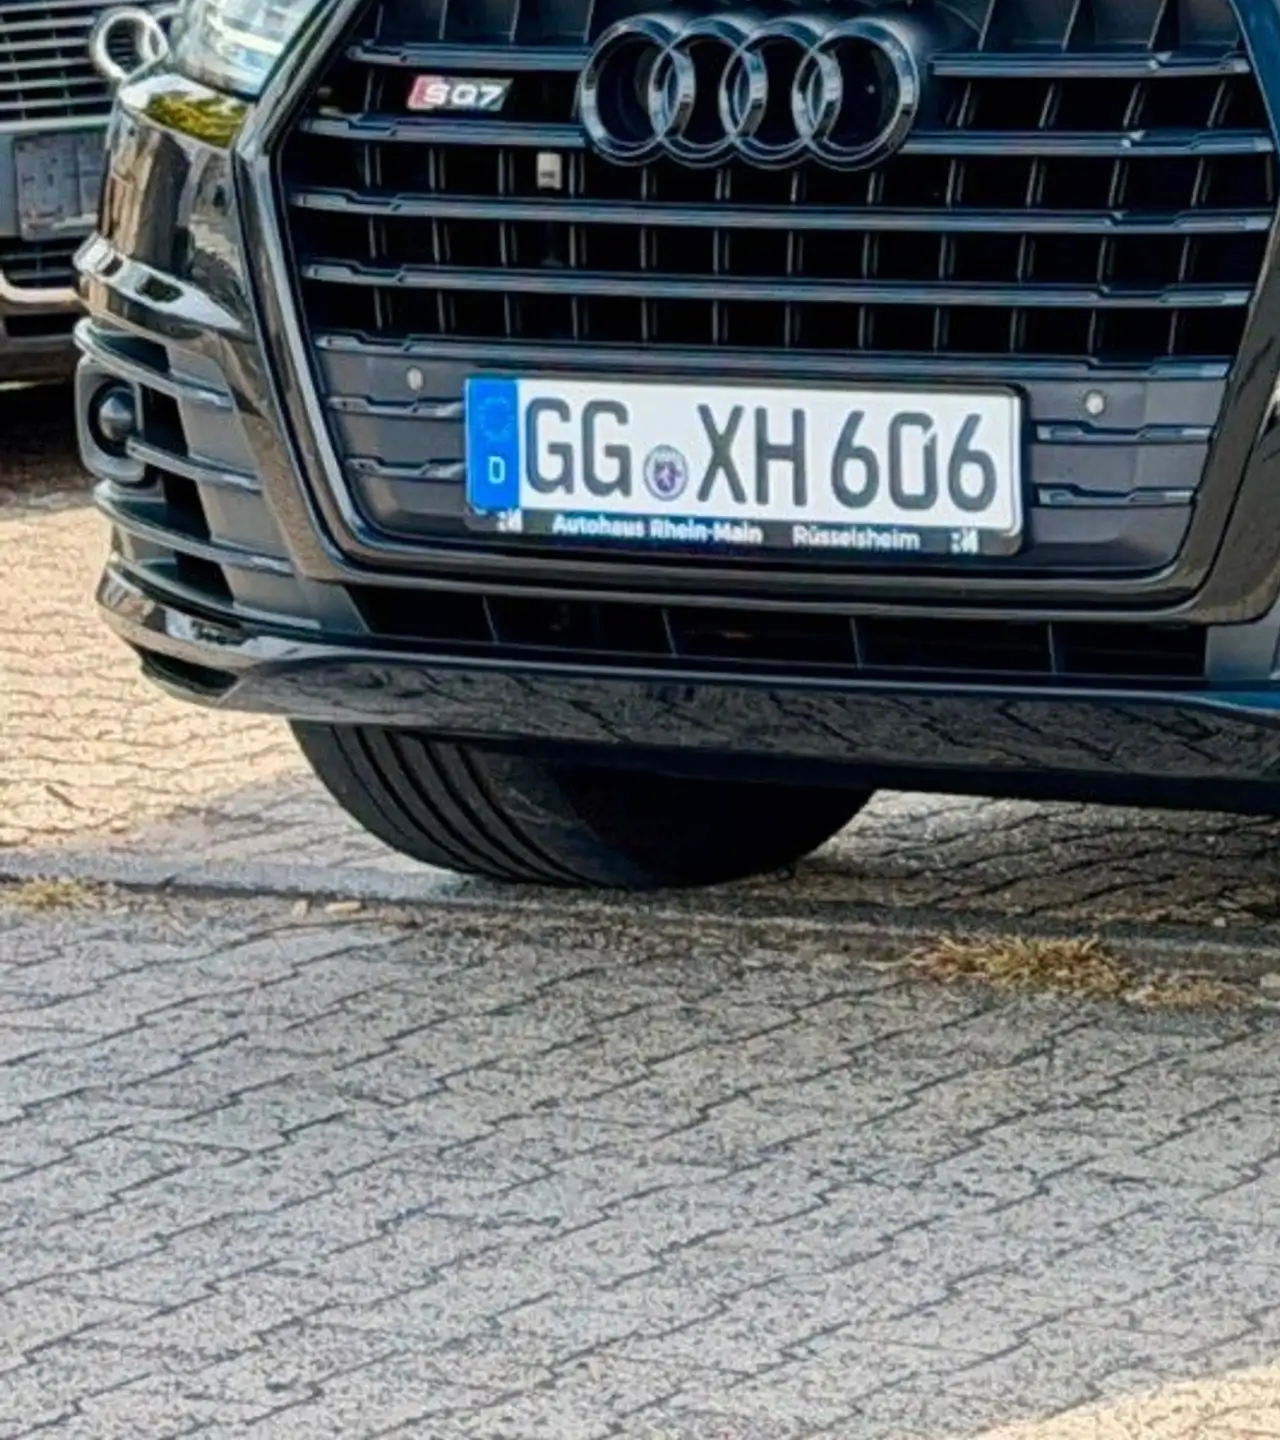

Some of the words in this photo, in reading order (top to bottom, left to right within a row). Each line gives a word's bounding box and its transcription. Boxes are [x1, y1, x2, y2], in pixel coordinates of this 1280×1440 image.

[422, 83, 504, 108] SQ7
[487, 455, 506, 485] D
[524, 396, 632, 498] GG
[696, 403, 808, 507] XH
[830, 409, 998, 513] 606
[552, 512, 645, 538] Autohaus
[650, 516, 765, 545] Rhein-Main
[791, 524, 921, 551] Rüsselsheim
